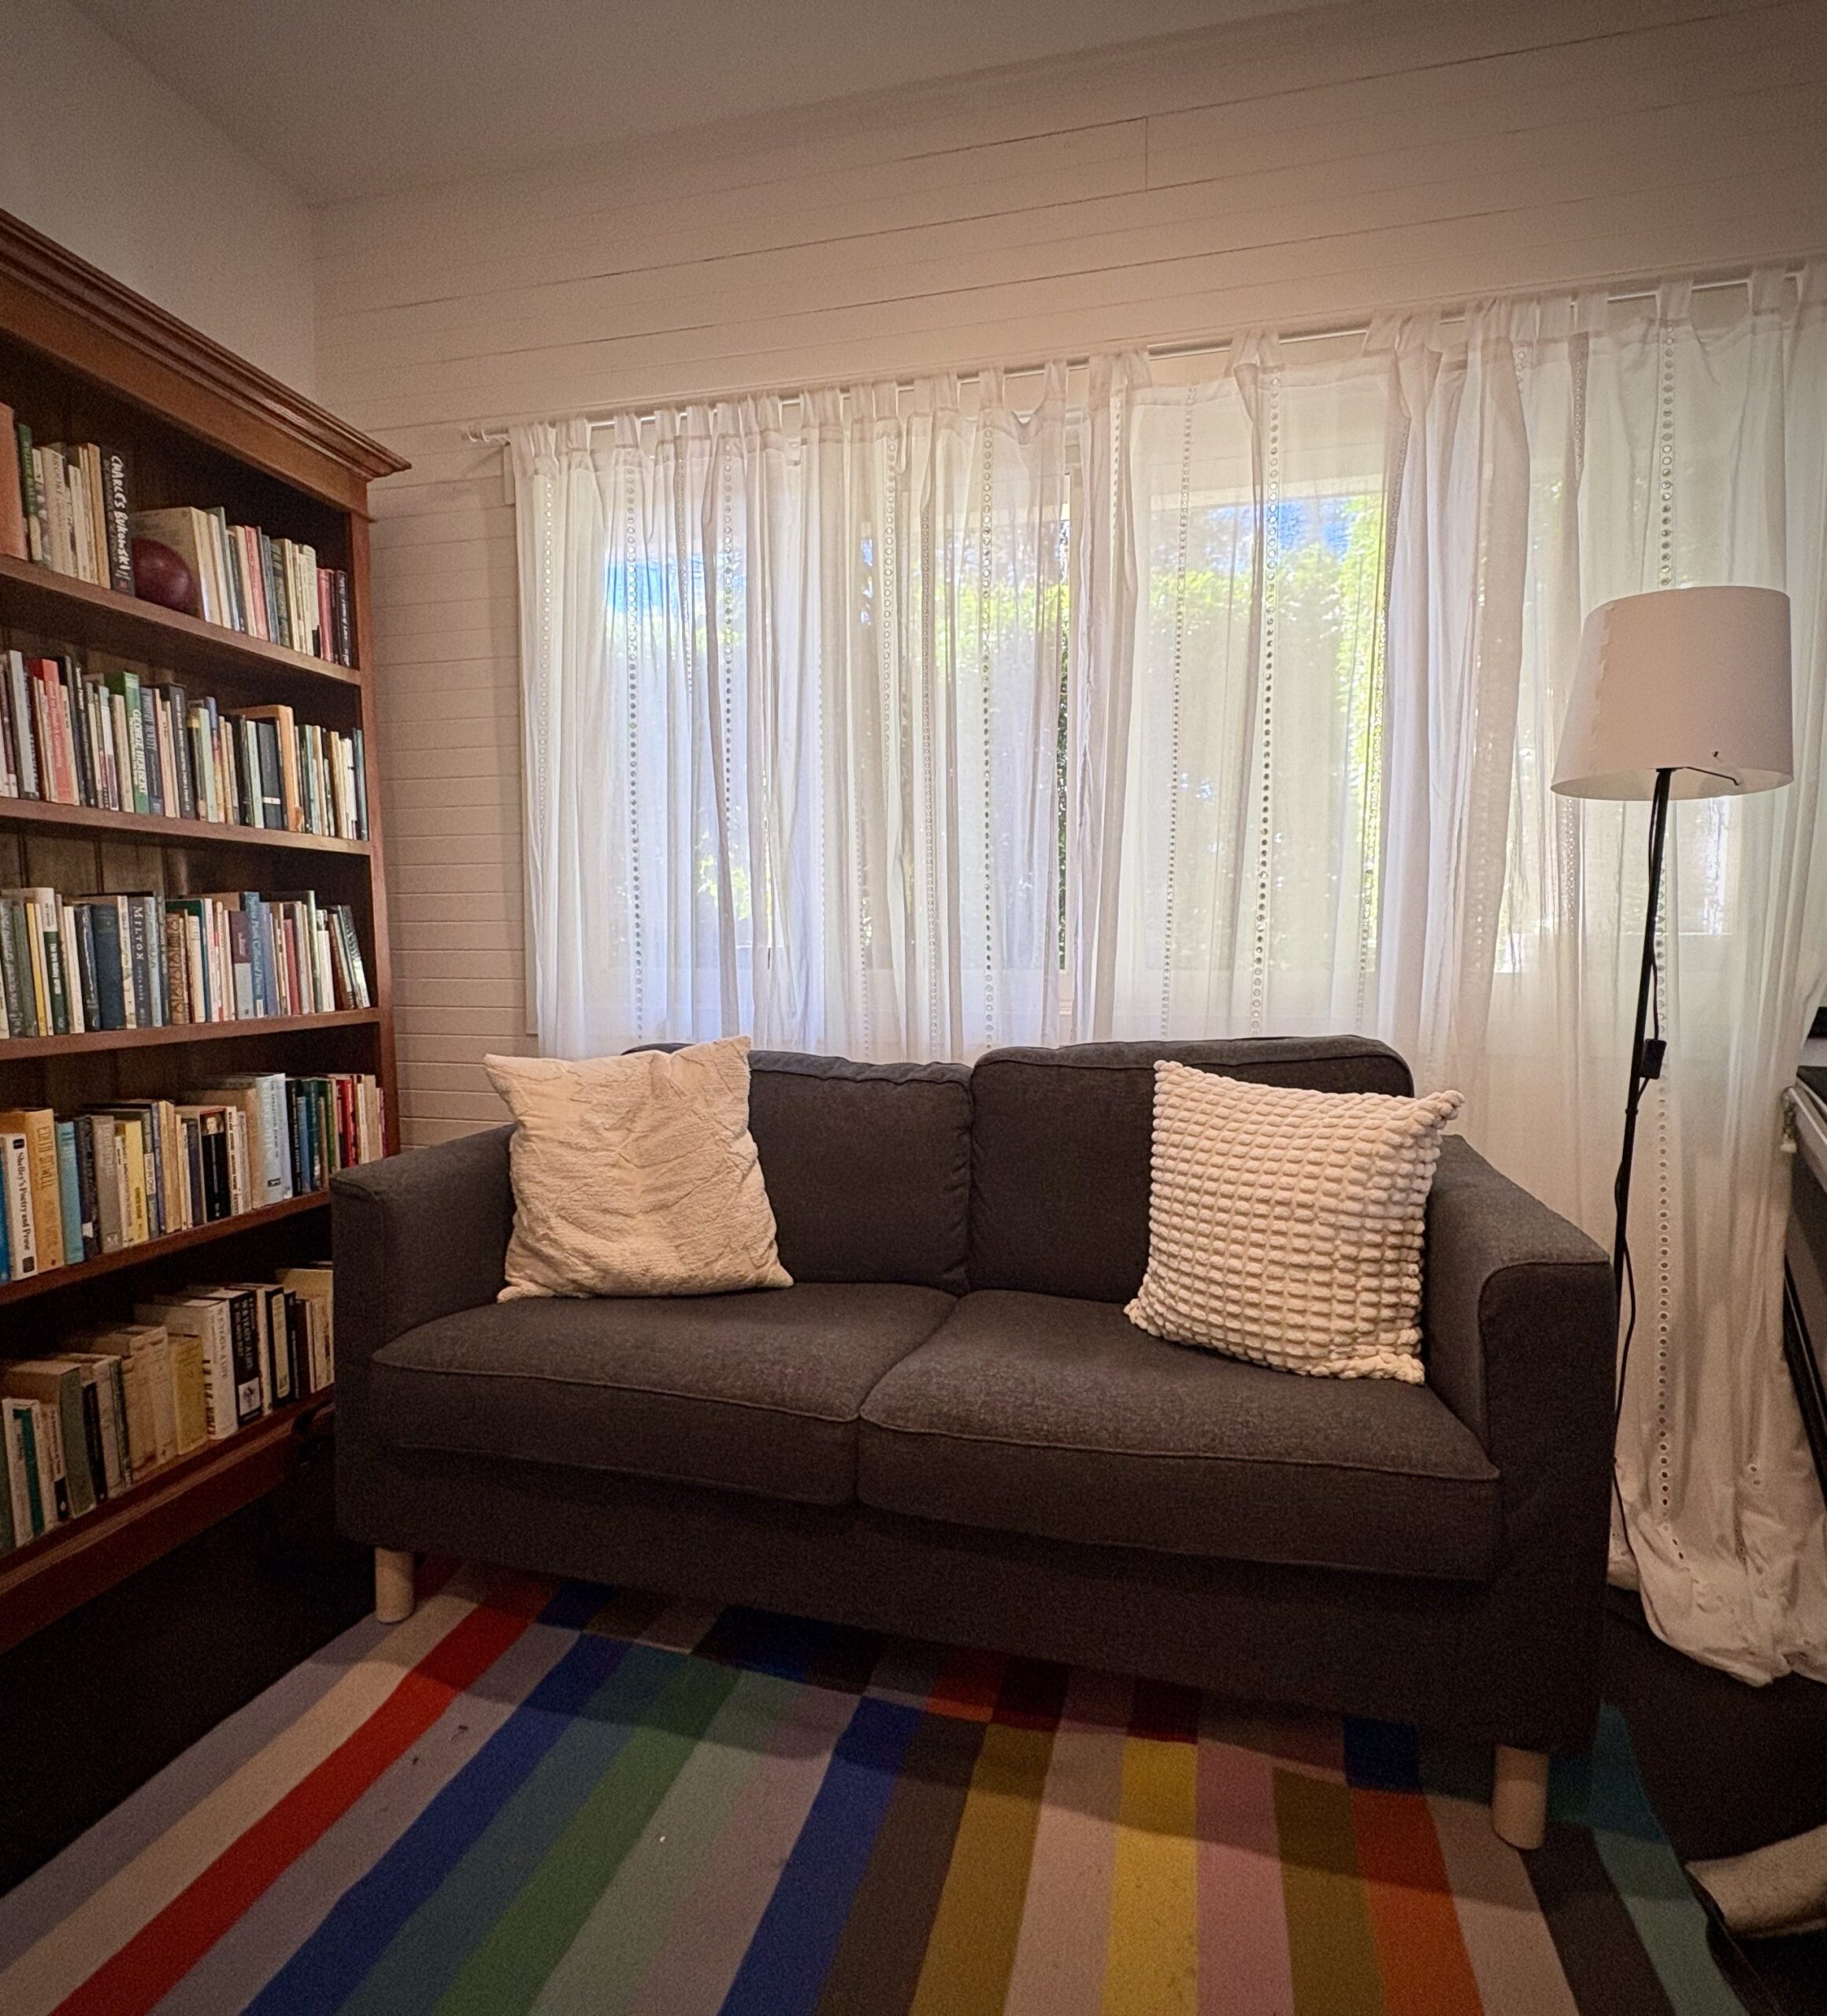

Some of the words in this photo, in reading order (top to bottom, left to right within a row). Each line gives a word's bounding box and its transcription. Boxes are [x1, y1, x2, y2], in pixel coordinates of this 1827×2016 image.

[111, 455, 125, 508] CHARLES
[115, 510, 131, 569] BUKOWSKI
[133, 710, 143, 750] GEORGE
[136, 750, 147, 795] HERBERT
[133, 906, 146, 960] MILTON
[17, 1152, 25, 1186] Shelley's
[19, 1187, 28, 1211] Poetry
